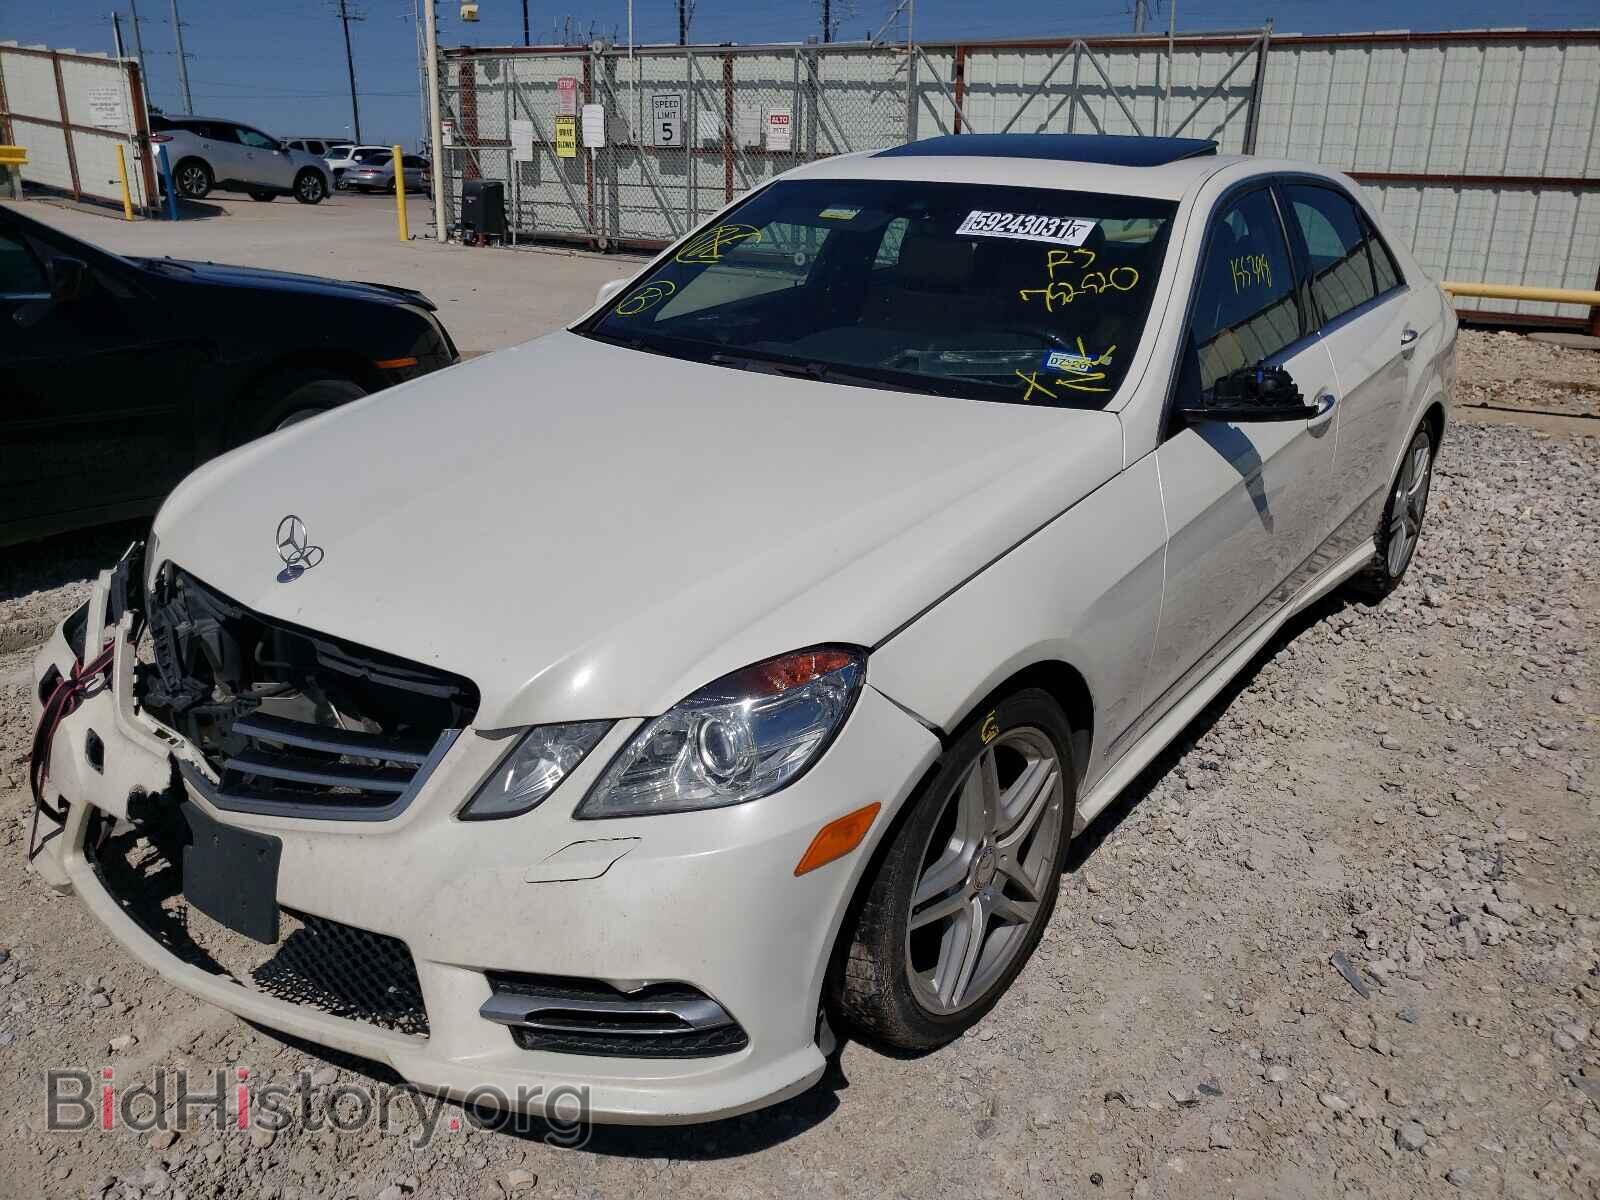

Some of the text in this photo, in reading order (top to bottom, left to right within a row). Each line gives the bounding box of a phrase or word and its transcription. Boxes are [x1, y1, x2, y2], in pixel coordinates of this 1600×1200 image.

[558, 79, 575, 89] STOP
[657, 111, 677, 119] LIMIT
[771, 116, 788, 124] ALTO
[662, 122, 673, 141] 5
[970, 211, 1073, 239] 59243031
